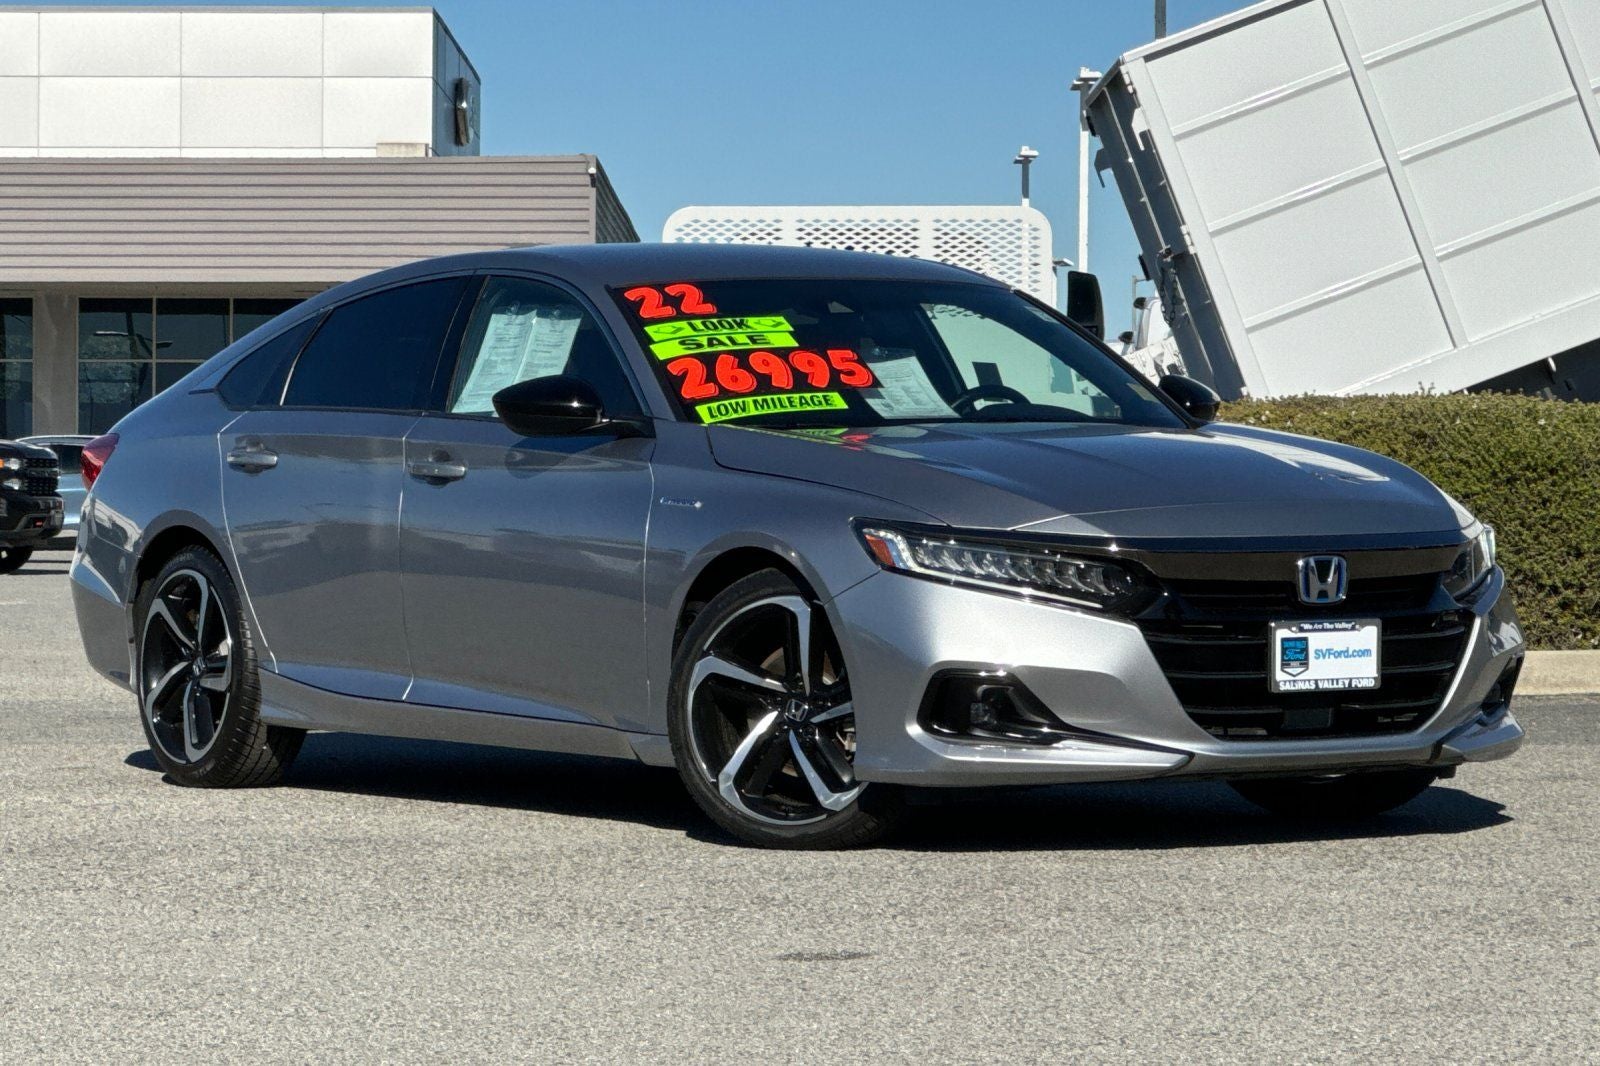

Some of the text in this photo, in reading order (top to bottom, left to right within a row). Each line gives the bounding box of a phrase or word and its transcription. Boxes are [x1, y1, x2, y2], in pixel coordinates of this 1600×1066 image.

[624, 283, 717, 318] 22
[687, 318, 752, 333] LOOK
[678, 334, 770, 350] SALE
[667, 349, 873, 399] 26995
[708, 394, 834, 420] LOW MILEAGE
[1313, 646, 1372, 660] SVFord.com
[1317, 679, 1350, 689] VALLEY
[1351, 678, 1375, 688] FORD
